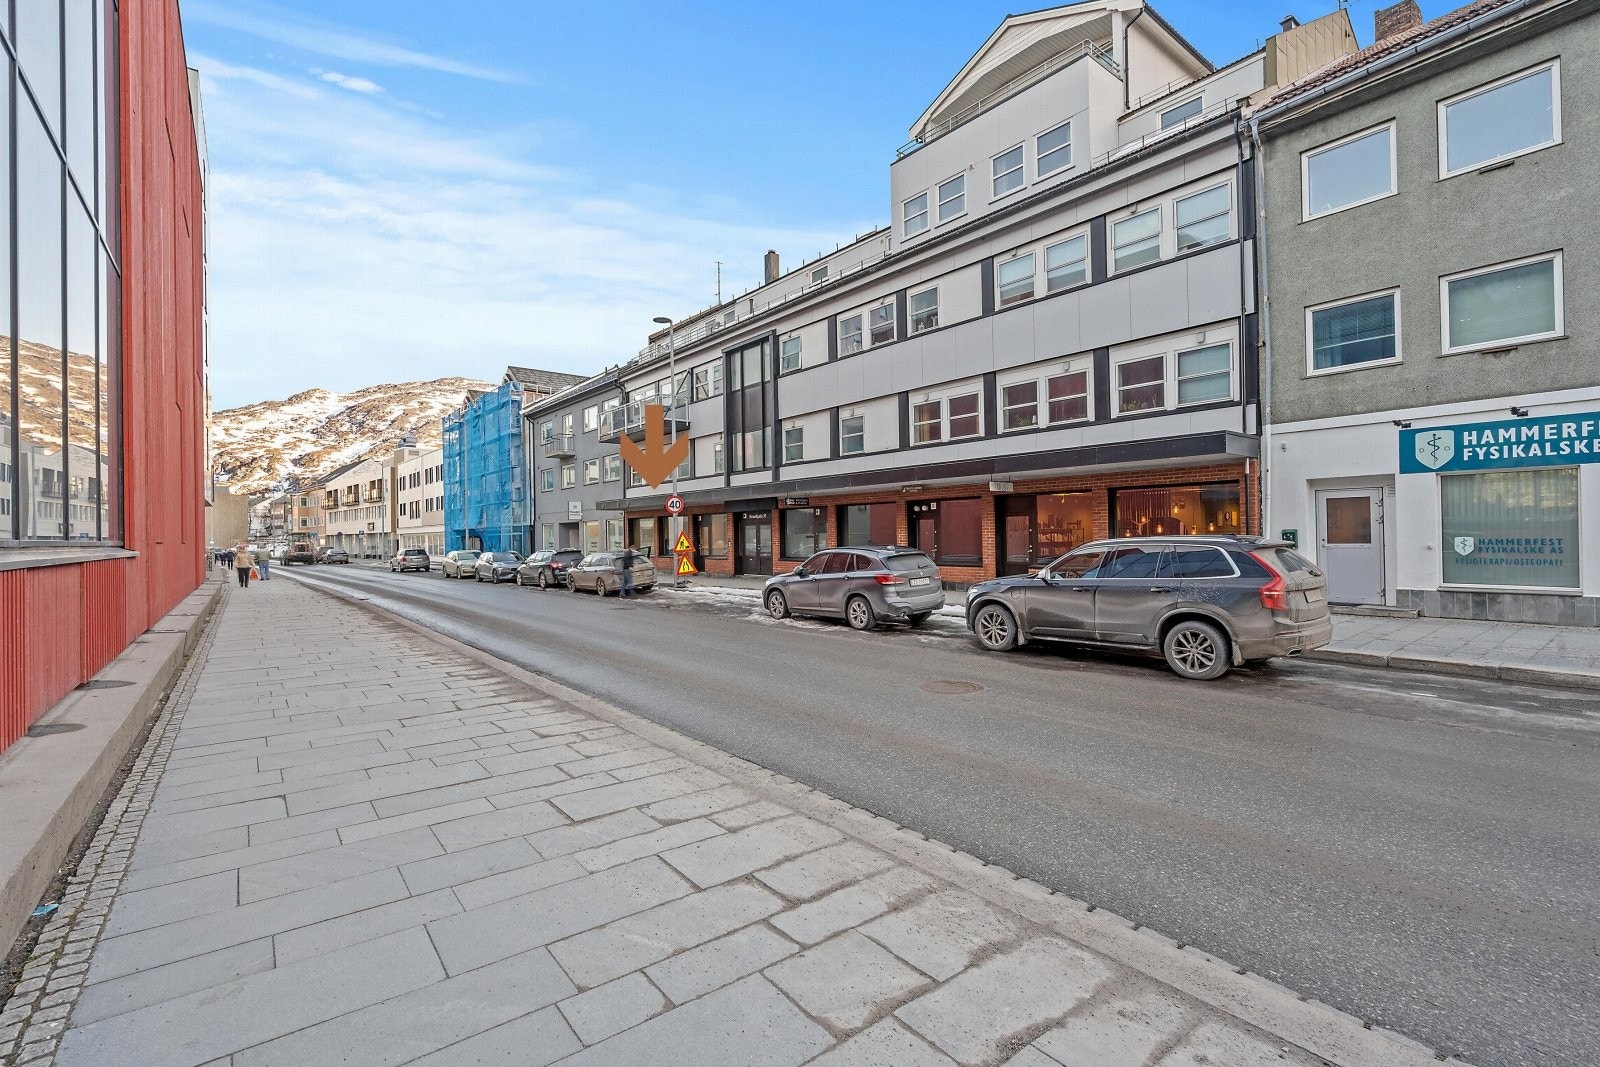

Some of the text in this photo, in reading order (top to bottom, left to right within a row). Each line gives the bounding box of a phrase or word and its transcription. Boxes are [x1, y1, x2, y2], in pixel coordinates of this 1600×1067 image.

[1463, 420, 1600, 446] HAMMERF
[1463, 438, 1600, 461] FYSIKALSKE
[669, 500, 681, 509] 40
[1478, 538, 1564, 546] HAMMERFEST
[1478, 546, 1564, 554] FYSIKALSKE AS
[1455, 558, 1563, 567] FYSIOTERAPI/OSTEOPATI
